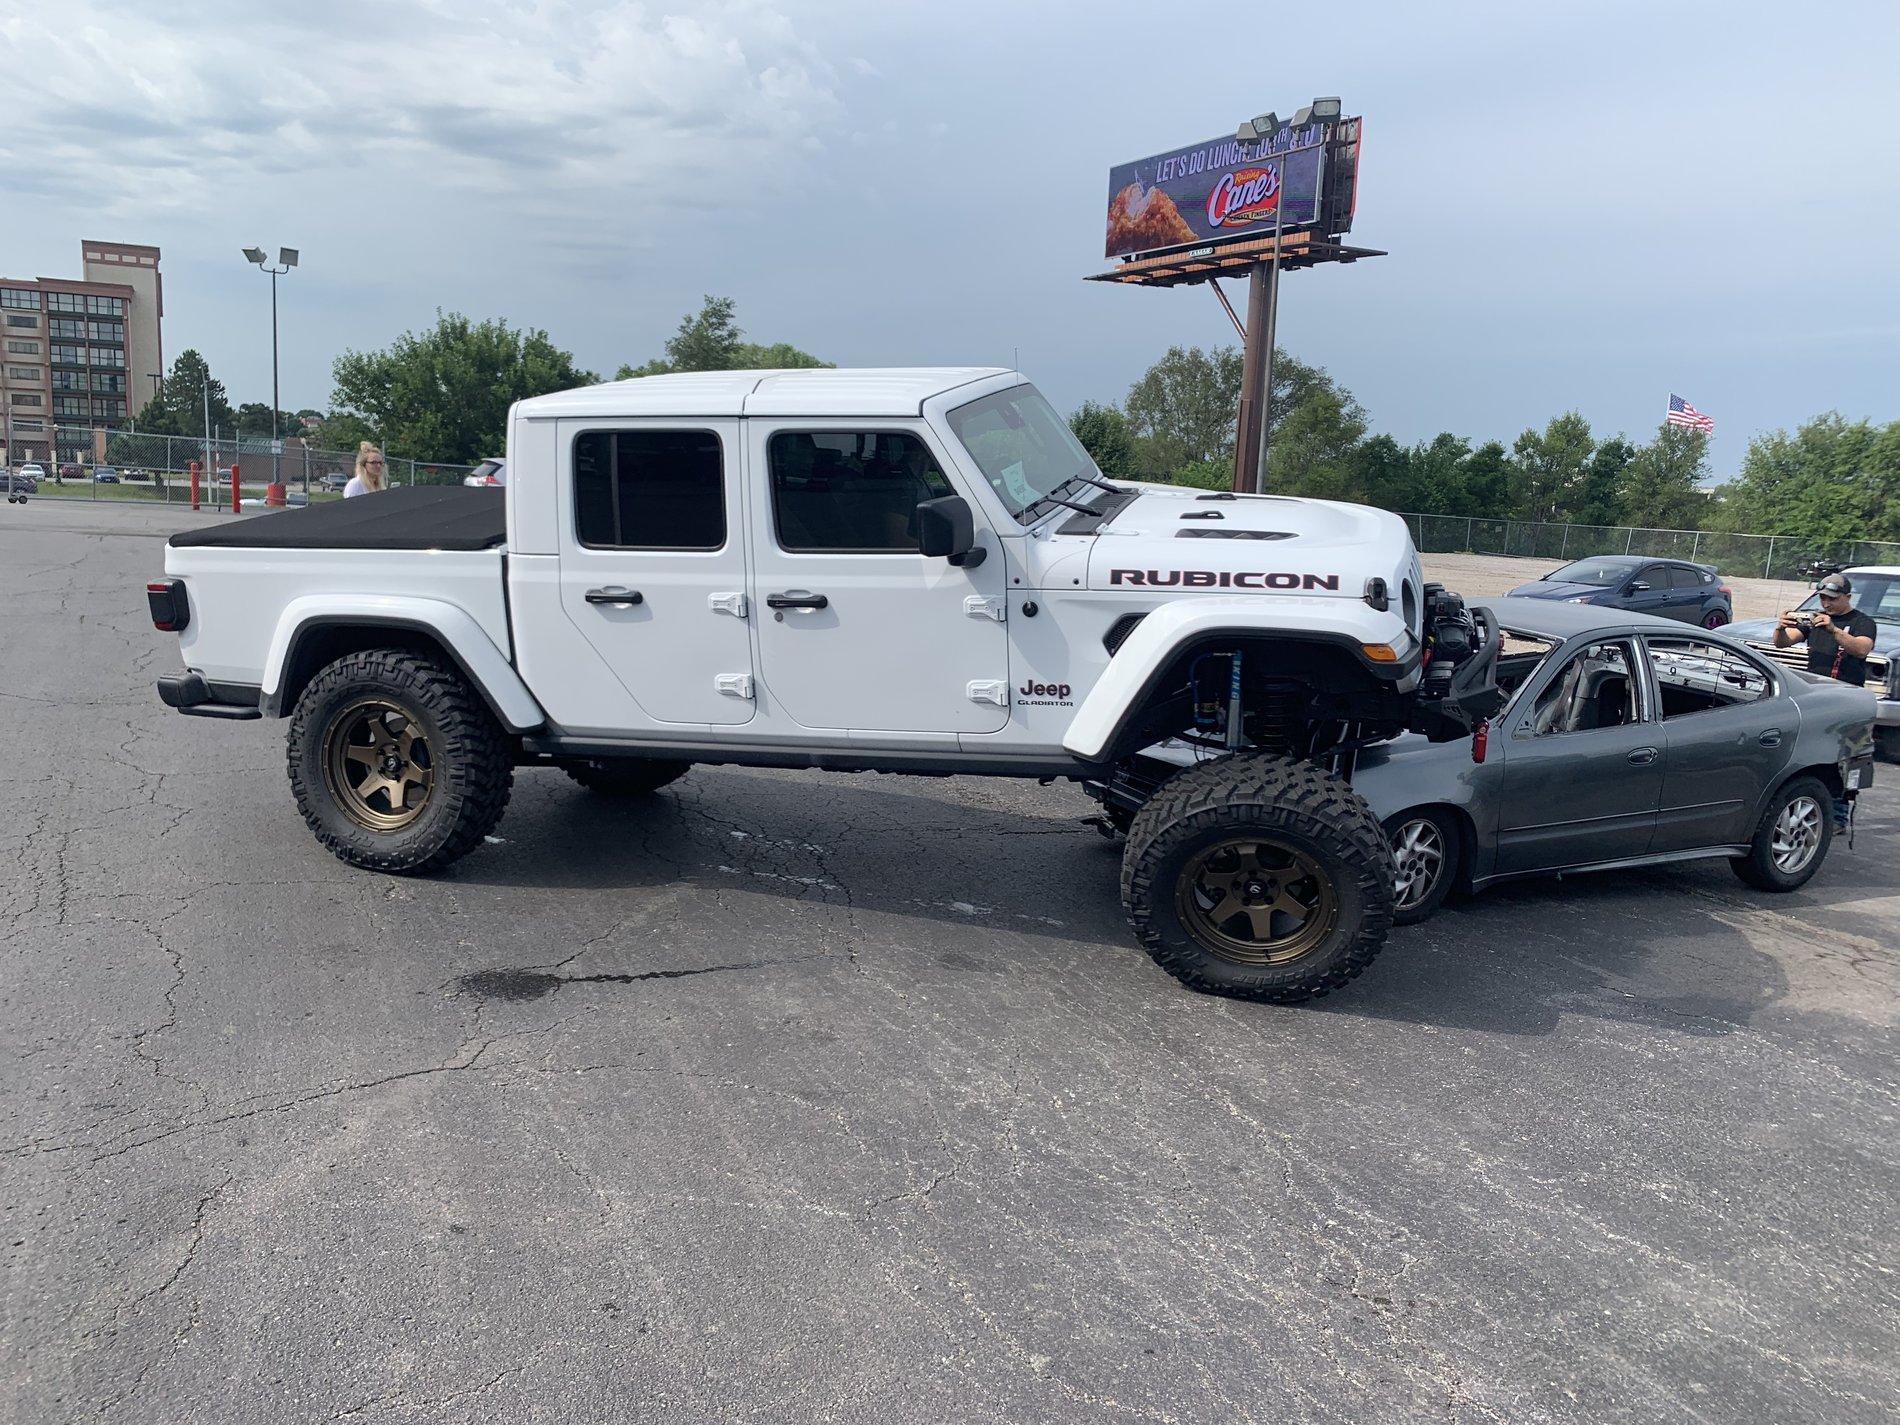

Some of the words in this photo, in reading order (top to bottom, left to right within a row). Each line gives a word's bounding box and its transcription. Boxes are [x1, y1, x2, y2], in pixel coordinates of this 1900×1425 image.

[1155, 157, 1188, 183] LET'S
[1188, 150, 1205, 176] DO
[1234, 170, 1261, 184] Raising
[1208, 163, 1280, 227] Cane's
[1110, 568, 1340, 591] RUBICON
[1020, 679, 1071, 700] Jeep
[1017, 699, 1074, 707] GLADIATOR
